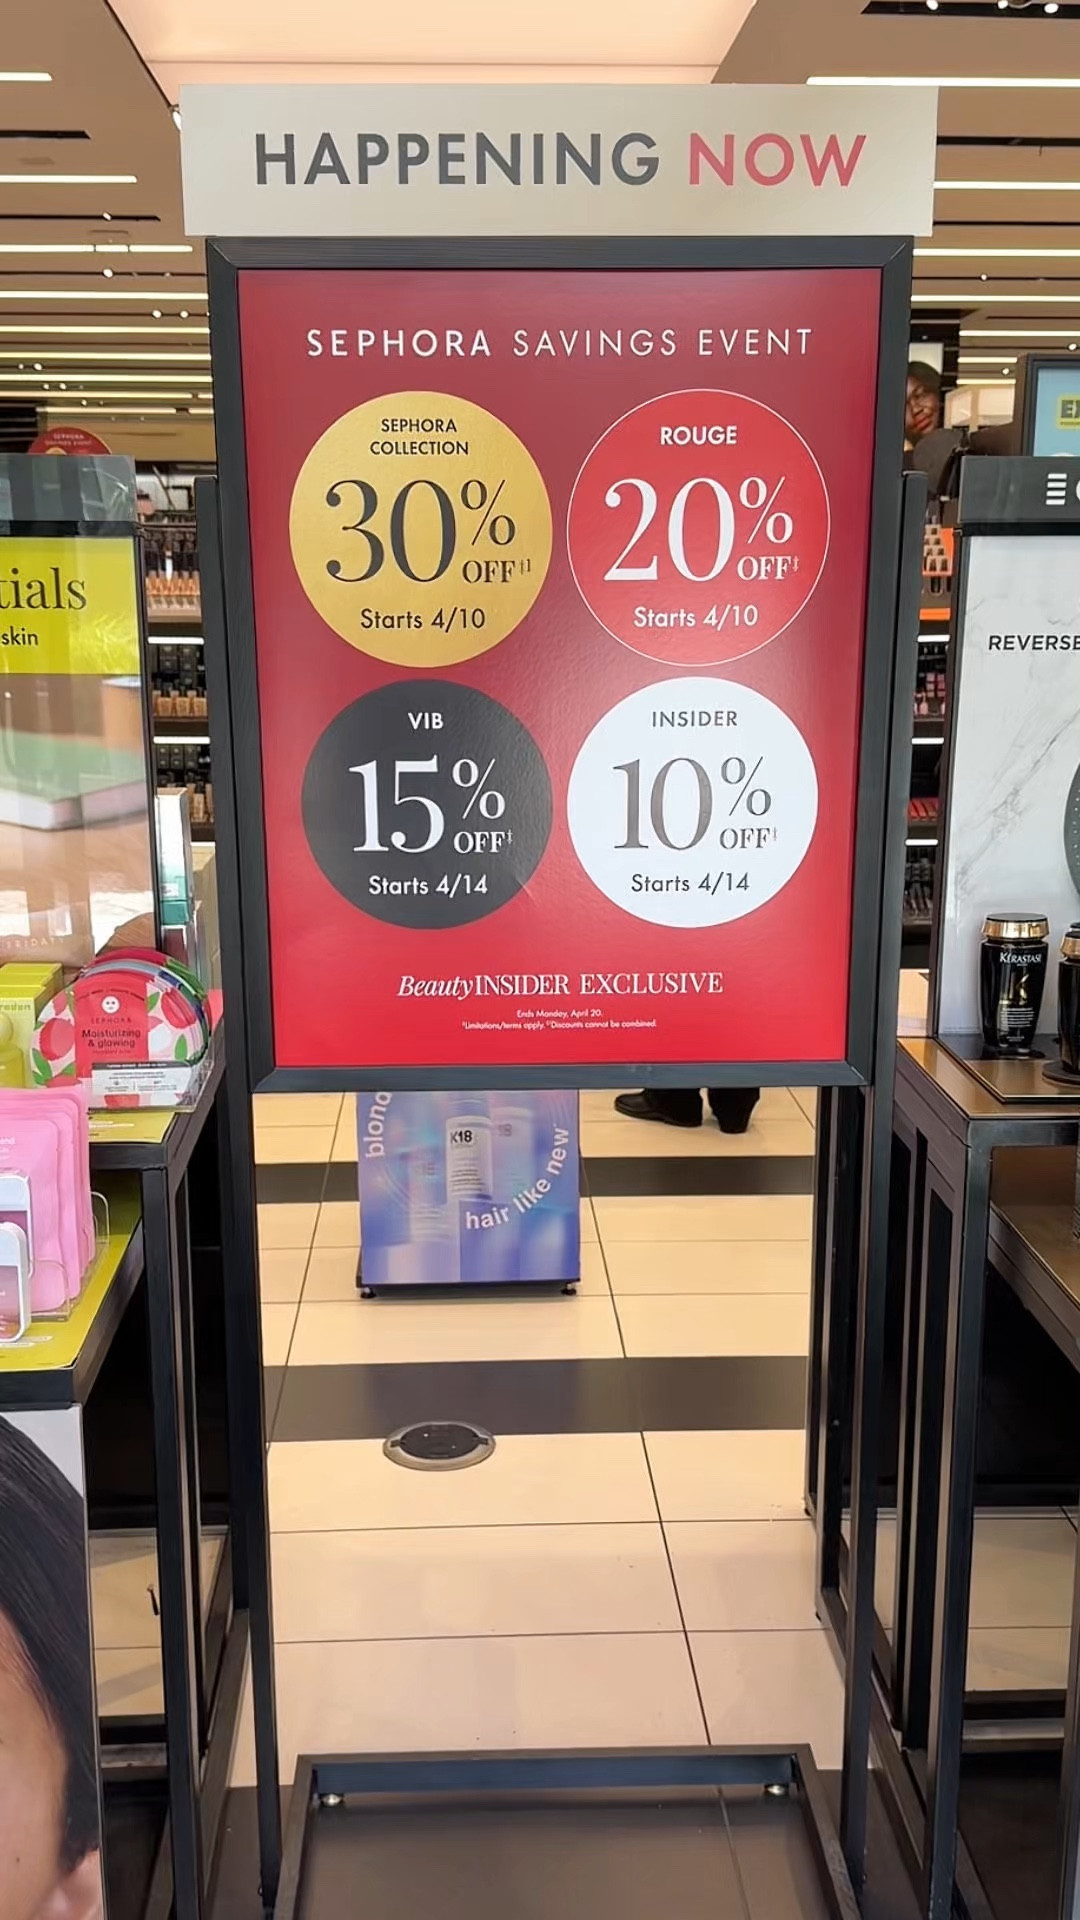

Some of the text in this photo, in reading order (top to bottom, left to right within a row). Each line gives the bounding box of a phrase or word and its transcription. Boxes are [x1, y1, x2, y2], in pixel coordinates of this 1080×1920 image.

[255, 131, 868, 187] HAPPENING NOW
[307, 328, 813, 358] SEPHORA SAVINGS EVENT
[381, 418, 458, 433] SEPHORA
[660, 425, 738, 446] ROUGE
[370, 441, 469, 456] COLLECTION
[325, 478, 516, 583] 30%
[603, 475, 794, 582] 20%
[360, 606, 486, 634] Starts 4/10
[633, 603, 759, 632] Starts 4/10
[1, 625, 39, 646] skin
[407, 712, 445, 730] VIB
[652, 710, 738, 728] INSIDER
[348, 753, 507, 854] 15%
[611, 755, 772, 851] 10%
[368, 872, 489, 899] Starts 4/14
[630, 871, 750, 896] Starts 4/14
[579, 972, 724, 995] EXCLUSIVE
[517, 1009, 534, 1018] Ends
[536, 1009, 568, 1019] Monday,
[570, 1009, 589, 1018] April
[523, 1021, 544, 1031] apply.
[585, 1020, 609, 1028] cannot
[611, 1019, 620, 1028] be
[82, 1029, 141, 1039] Moisturizing
[97, 1039, 136, 1049] glowing
[450, 1129, 473, 1144] K18
[465, 1207, 510, 1230] hair
[512, 1179, 552, 1214] like
